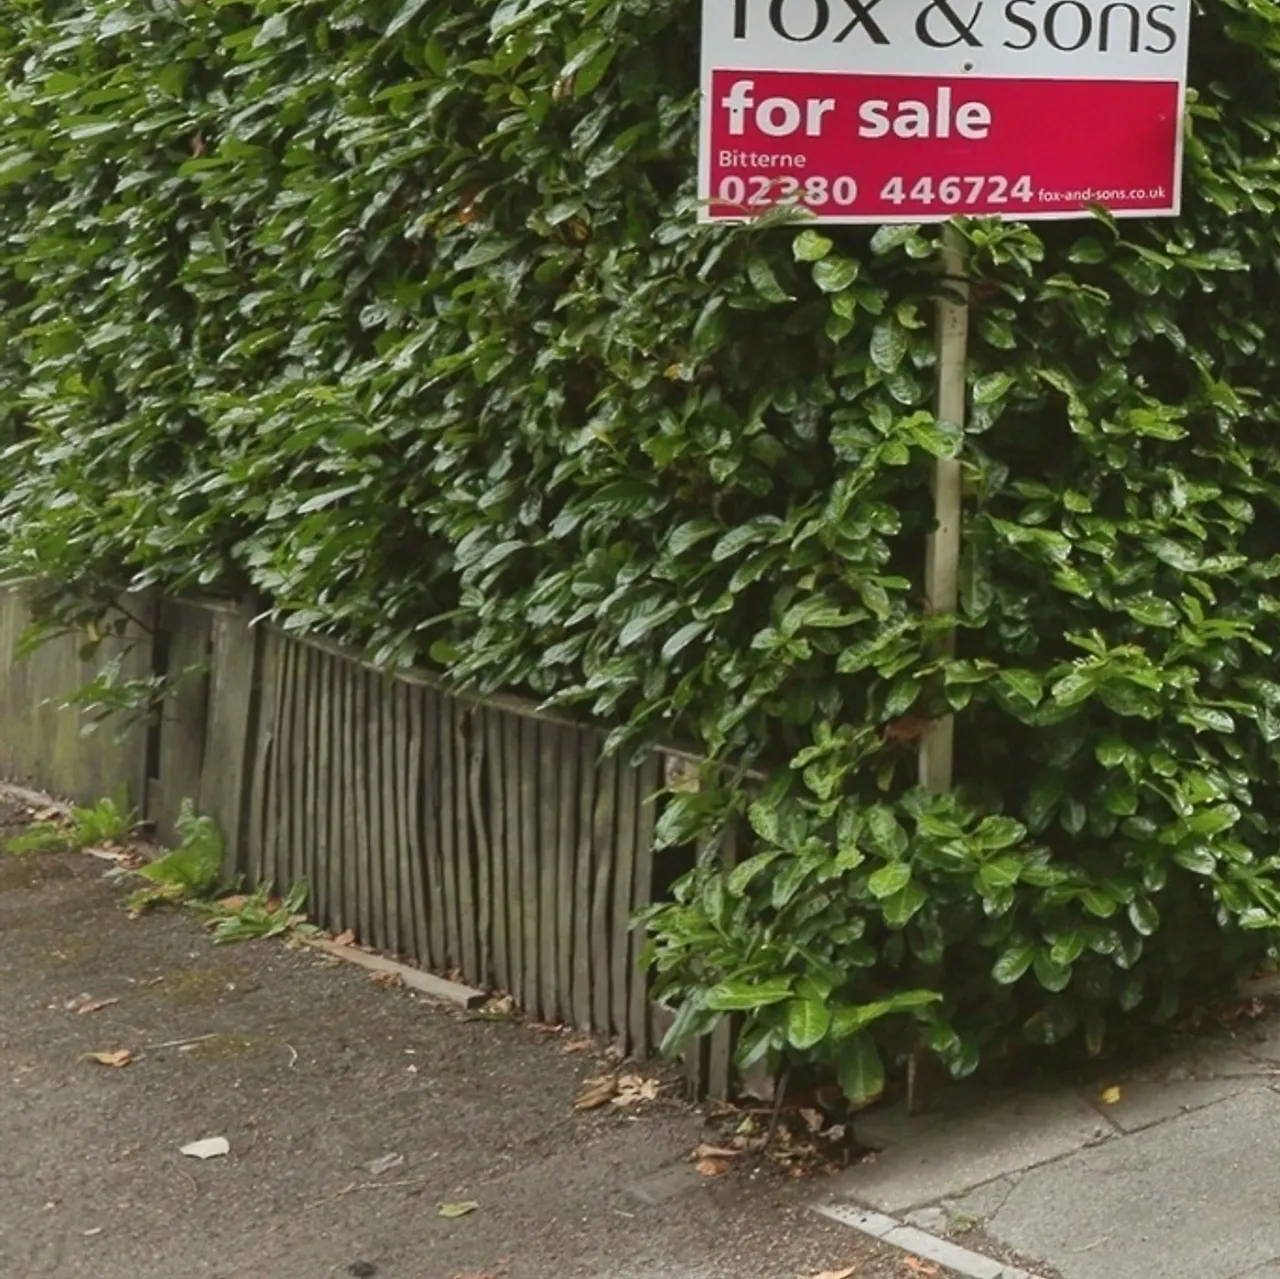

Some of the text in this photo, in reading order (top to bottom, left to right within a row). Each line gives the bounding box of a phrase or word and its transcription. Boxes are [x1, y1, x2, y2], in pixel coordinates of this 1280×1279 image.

[721, 80, 992, 139] for sale
[718, 150, 807, 168] Bitterne
[718, 174, 1034, 206] 02380 446724
[1038, 185, 1167, 203] fox-and-sons.co.uk
